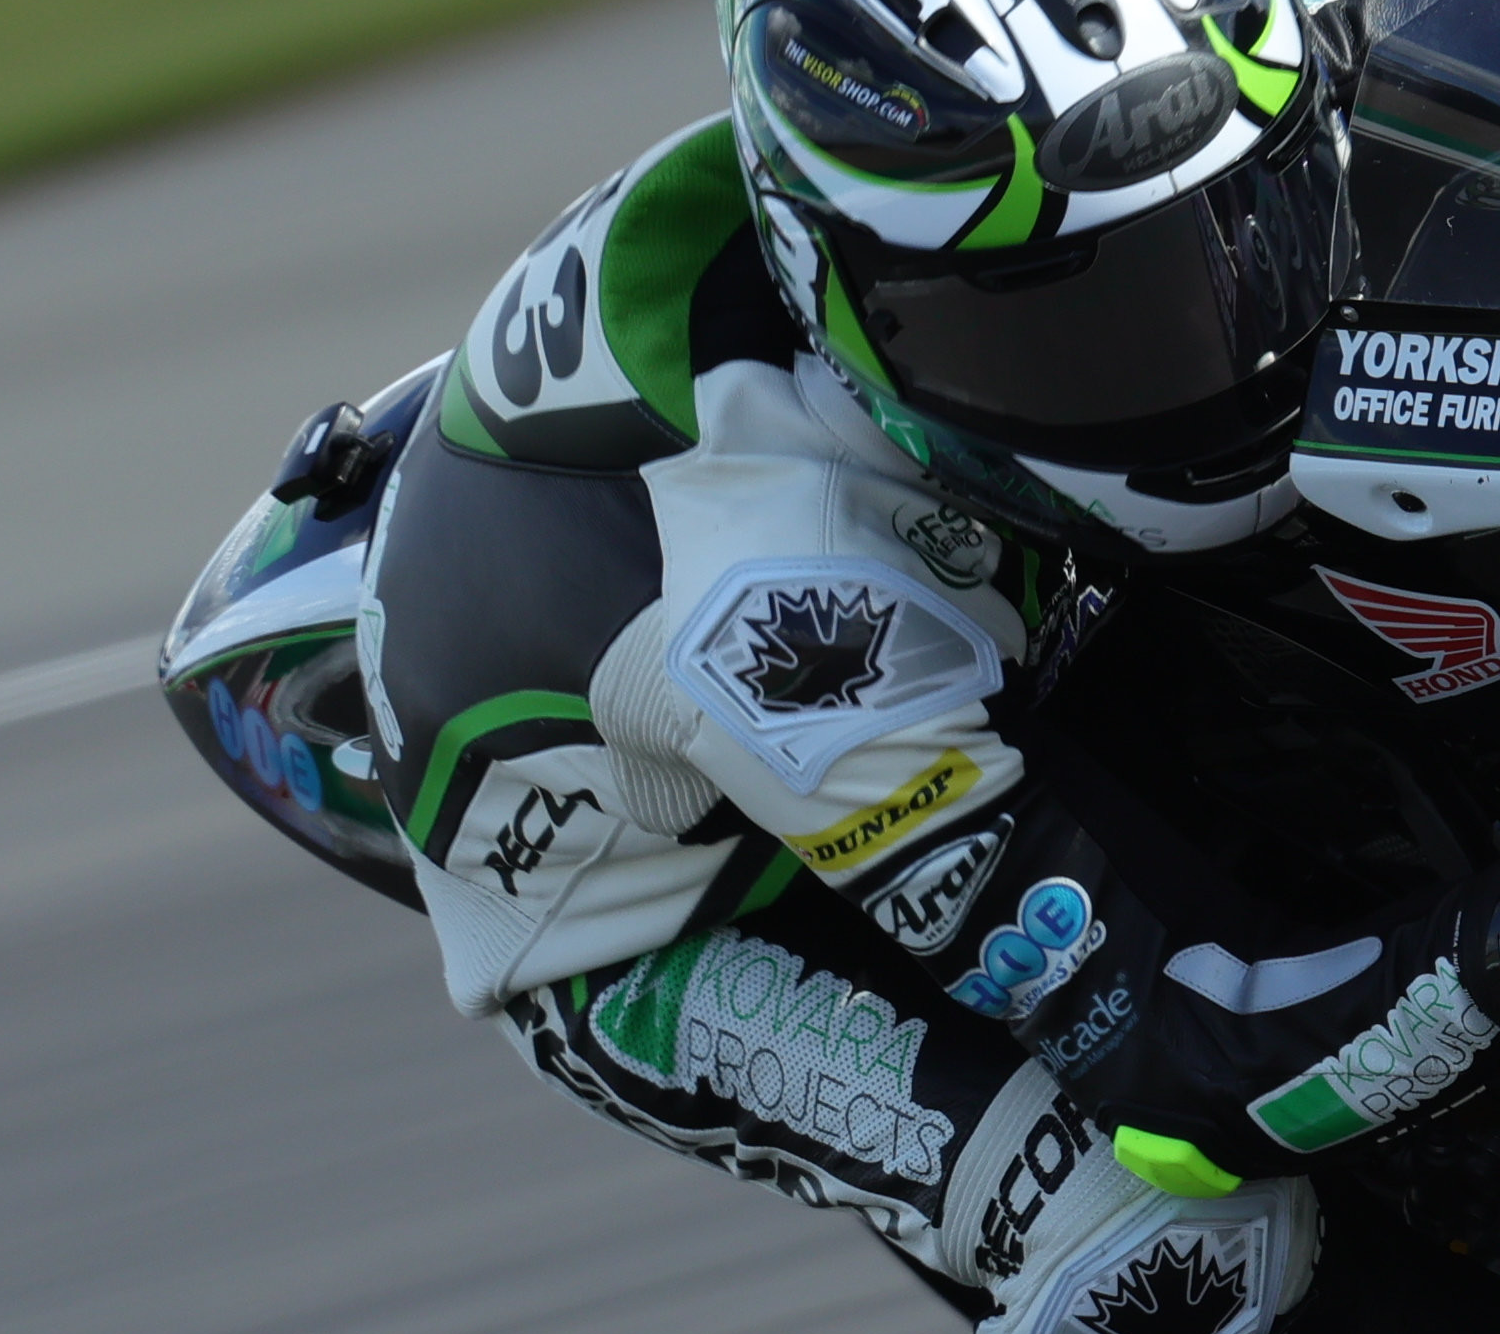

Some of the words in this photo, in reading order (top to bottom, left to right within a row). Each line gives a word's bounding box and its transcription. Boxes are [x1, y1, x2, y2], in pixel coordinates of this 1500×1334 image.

[1333, 386, 1432, 427] OFFICE
[816, 767, 955, 864] DUNLOP
[890, 836, 989, 938] Arai
[703, 947, 920, 1092] KOVARA
[1361, 1003, 1494, 1122] PROJEC
[687, 1018, 946, 1175] PROJECTS
